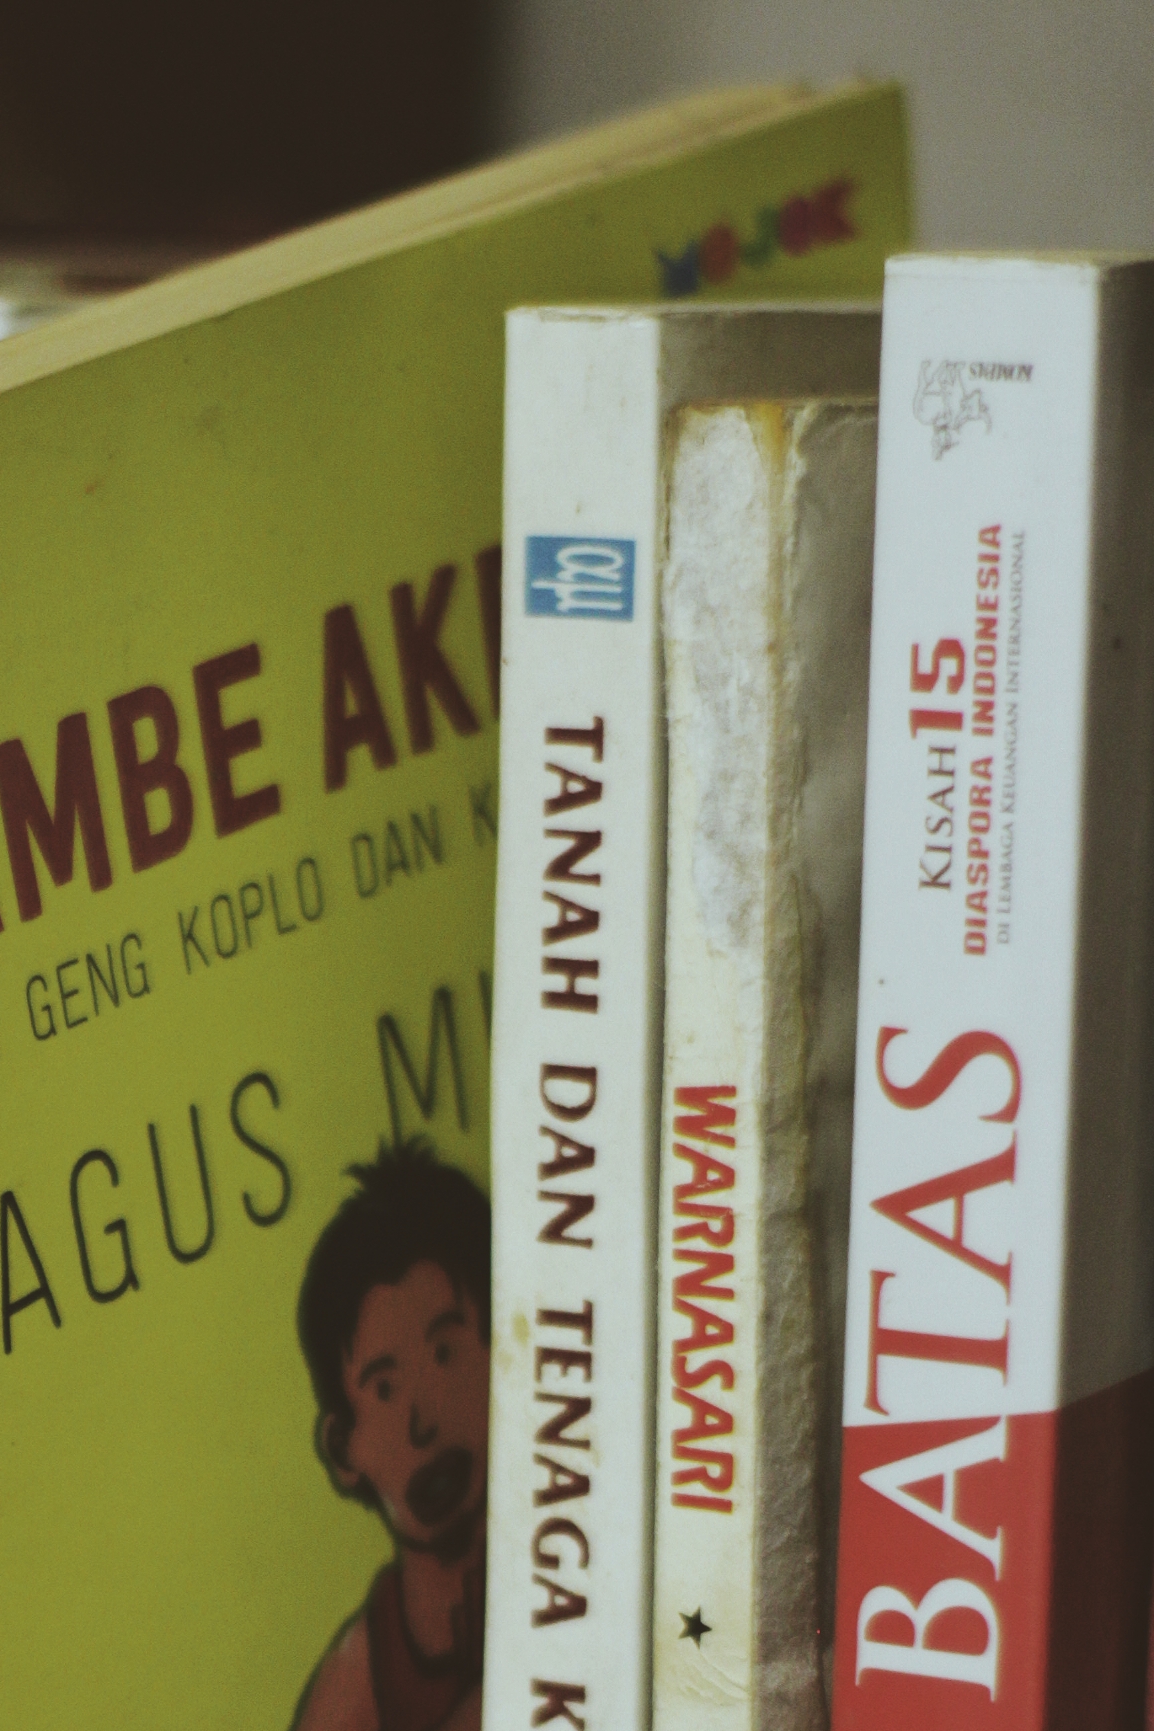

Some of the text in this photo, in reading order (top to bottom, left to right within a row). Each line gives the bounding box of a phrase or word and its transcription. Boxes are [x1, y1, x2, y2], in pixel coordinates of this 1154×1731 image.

[540, 716, 605, 1015] TANAH
[908, 637, 967, 892] KISAH 15
[963, 522, 1003, 957] DIASPORA INDONESIA
[996, 530, 1027, 946] DI LEMBAGA KEUANGAN INTERNASIONAL
[24, 931, 152, 1042] GENG
[176, 855, 327, 976] KOPLO
[349, 805, 445, 900] DAN
[0, 968, 494, 1356] AGUS M
[535, 1063, 598, 1250] DAN
[671, 1085, 737, 1515] WARNASARI
[529, 1300, 594, 1629] TENAGA
[854, 1024, 1023, 1703] BATAS
